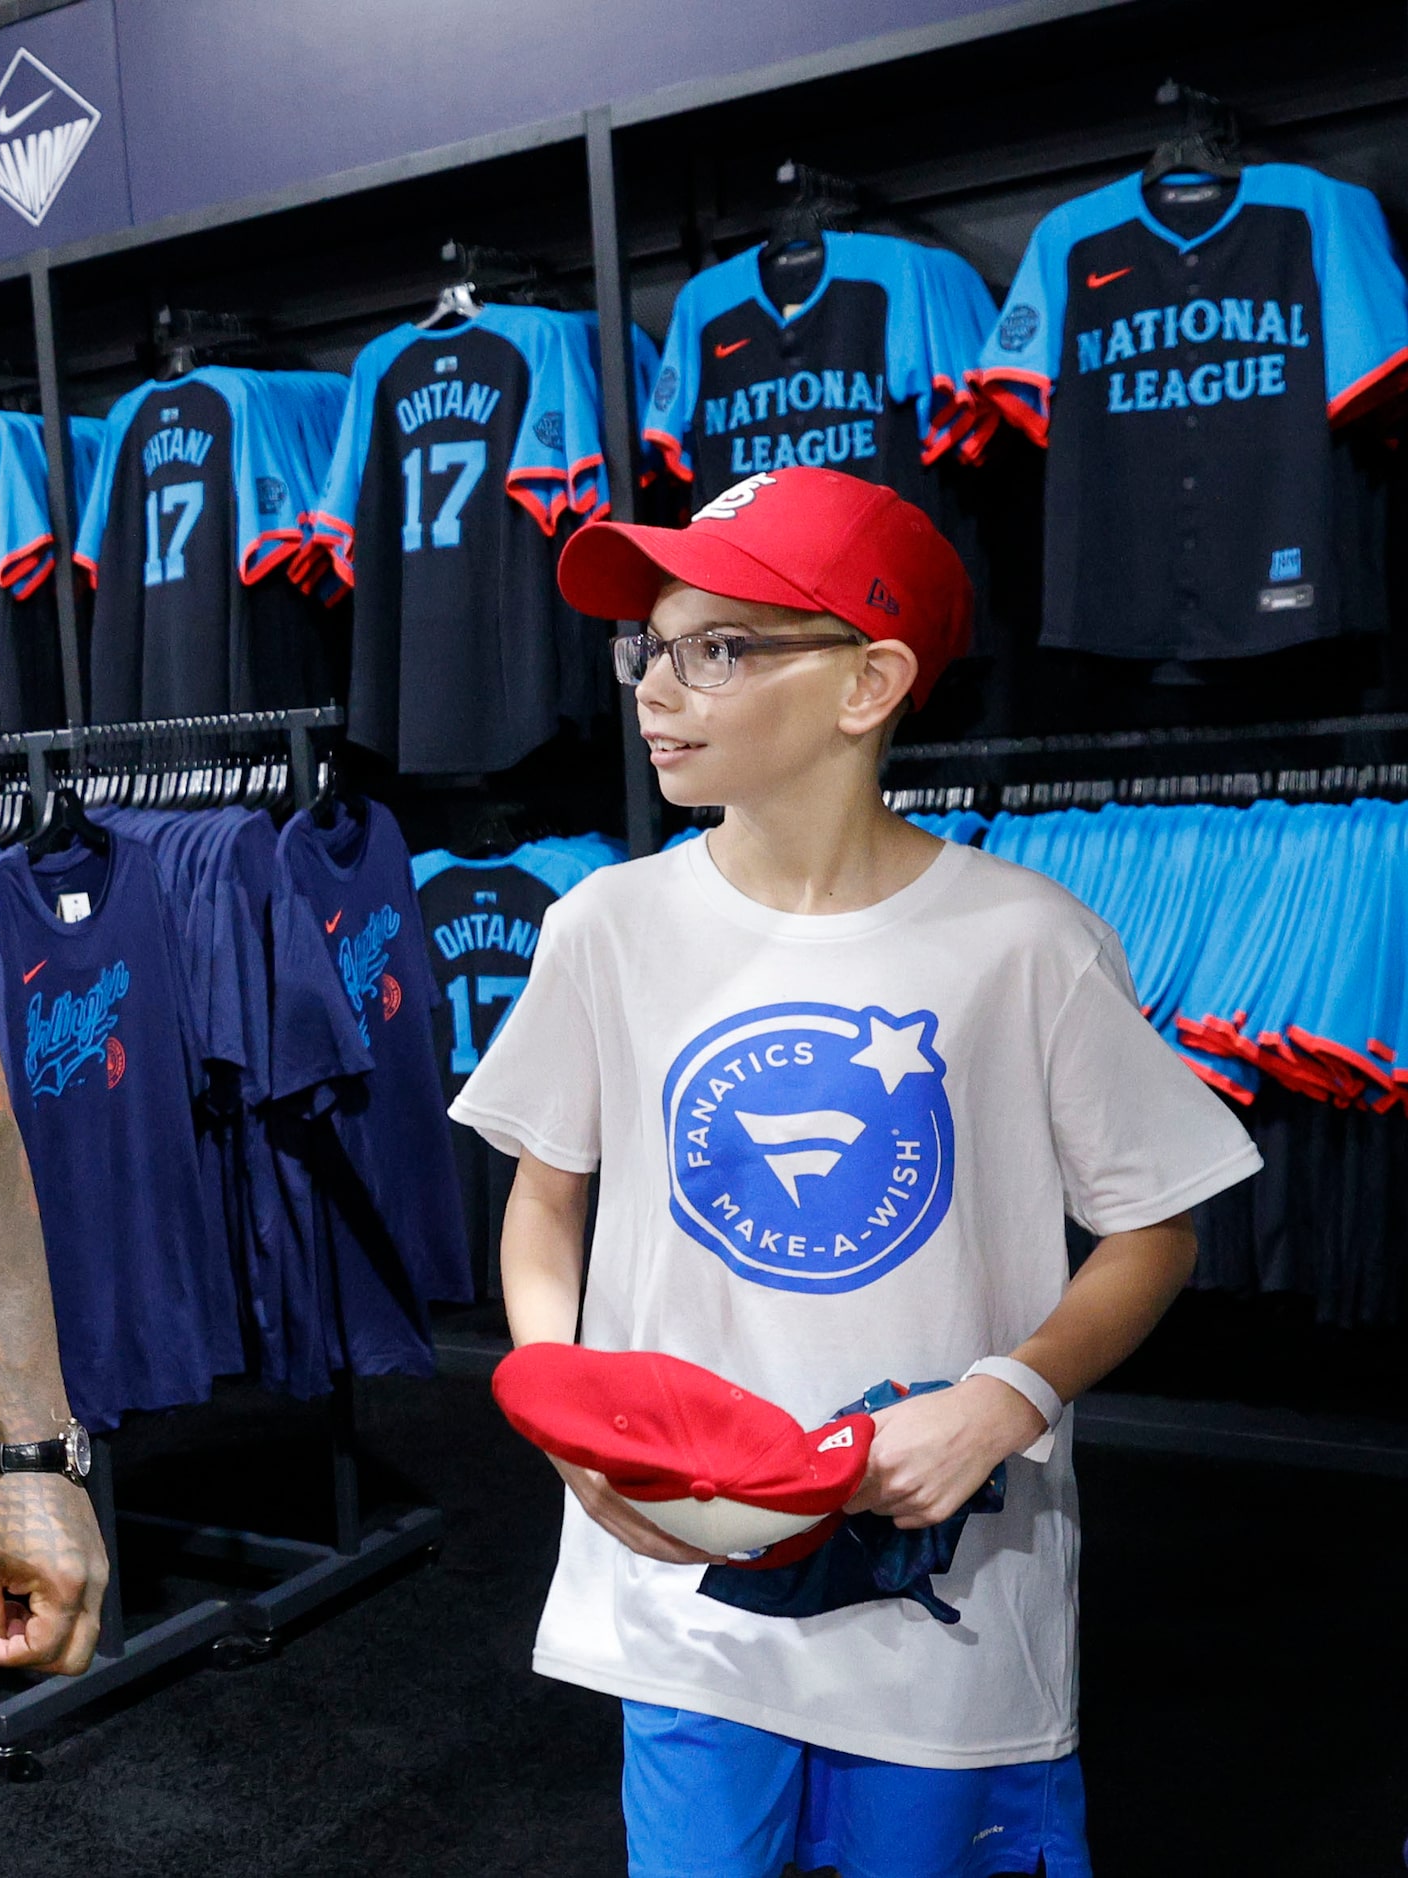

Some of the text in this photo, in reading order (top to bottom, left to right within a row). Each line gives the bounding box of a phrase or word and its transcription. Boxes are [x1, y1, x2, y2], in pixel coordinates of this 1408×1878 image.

[1077, 298, 1310, 375] NATIONAL
[396, 380, 502, 435] OHTANI
[1107, 354, 1287, 414] LEAGUE
[731, 419, 877, 474] LEAGUE
[402, 439, 486, 553] 17
[145, 481, 204, 587] 17
[433, 913, 541, 961] OHTANI
[687, 1041, 814, 1168] FANATICS
